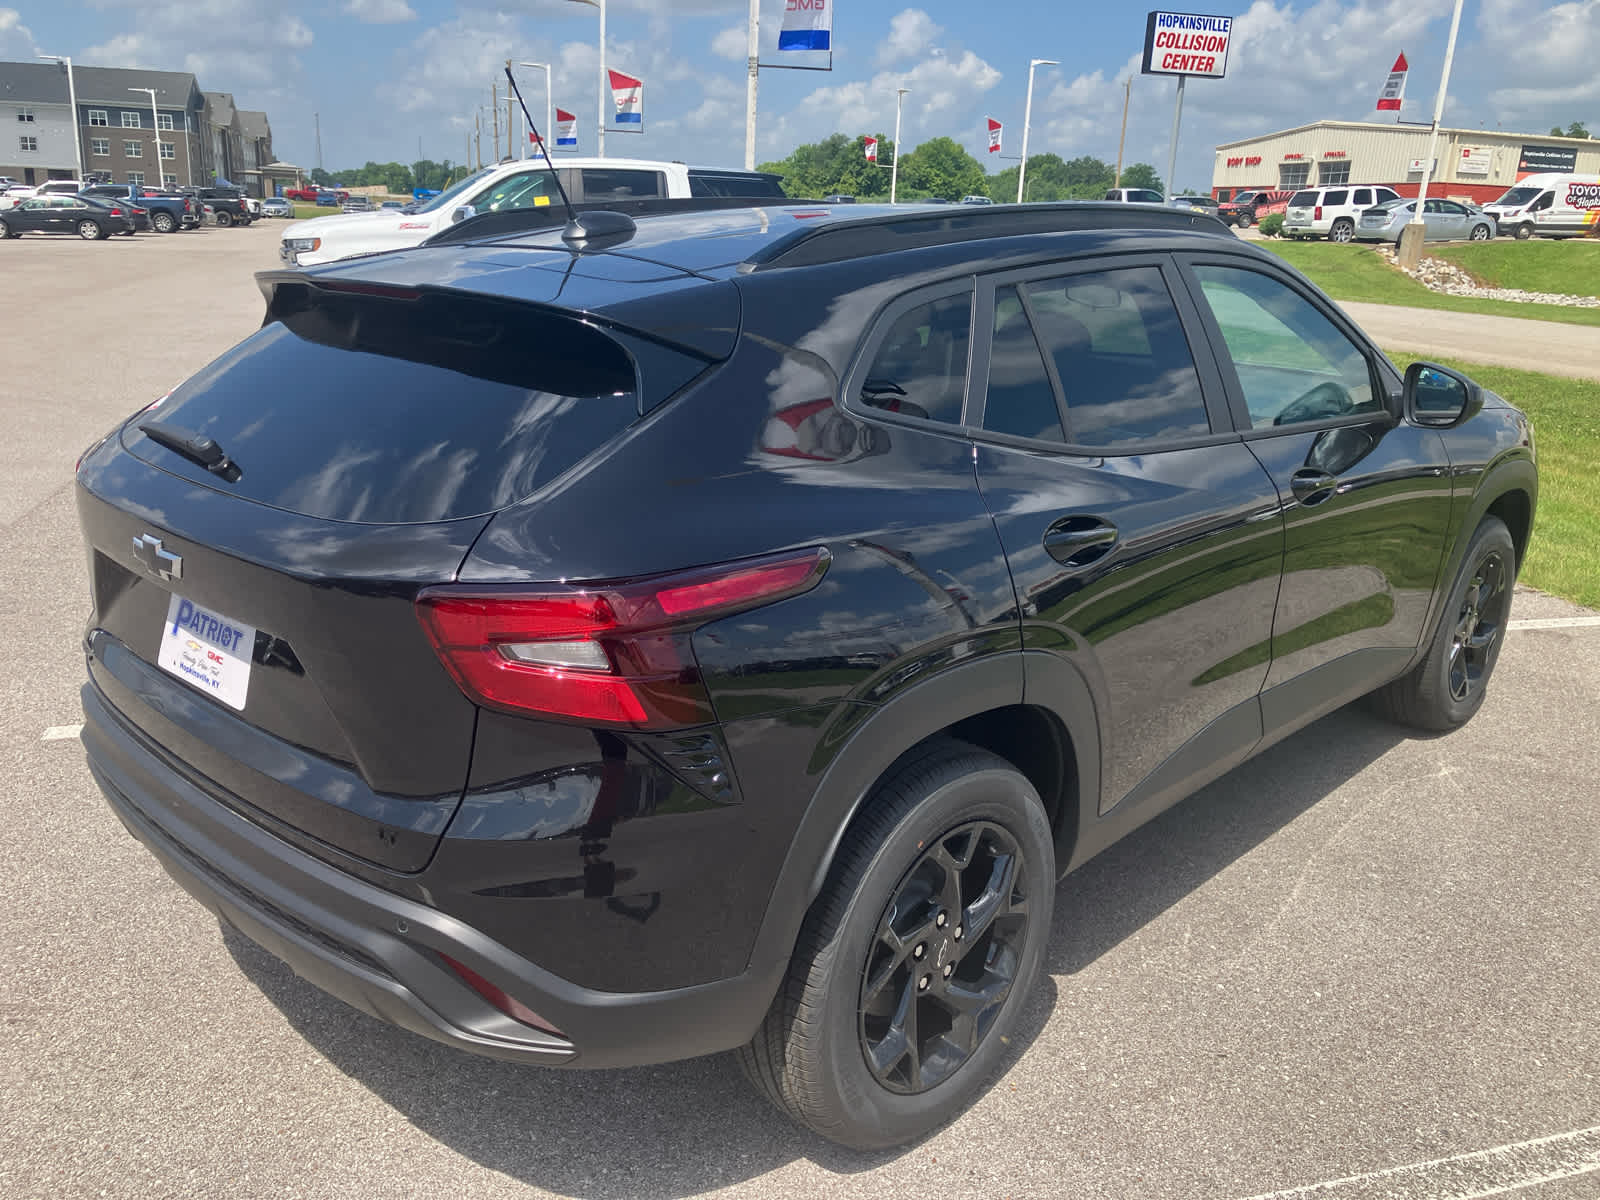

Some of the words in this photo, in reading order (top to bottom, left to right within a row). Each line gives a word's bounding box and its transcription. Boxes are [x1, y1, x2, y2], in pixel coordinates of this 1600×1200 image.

[1159, 14, 1229, 32] HOPKINSVILLE
[1156, 31, 1227, 52] COLLISION
[1162, 53, 1215, 72] CENTER
[172, 598, 244, 652] PATRIOT
